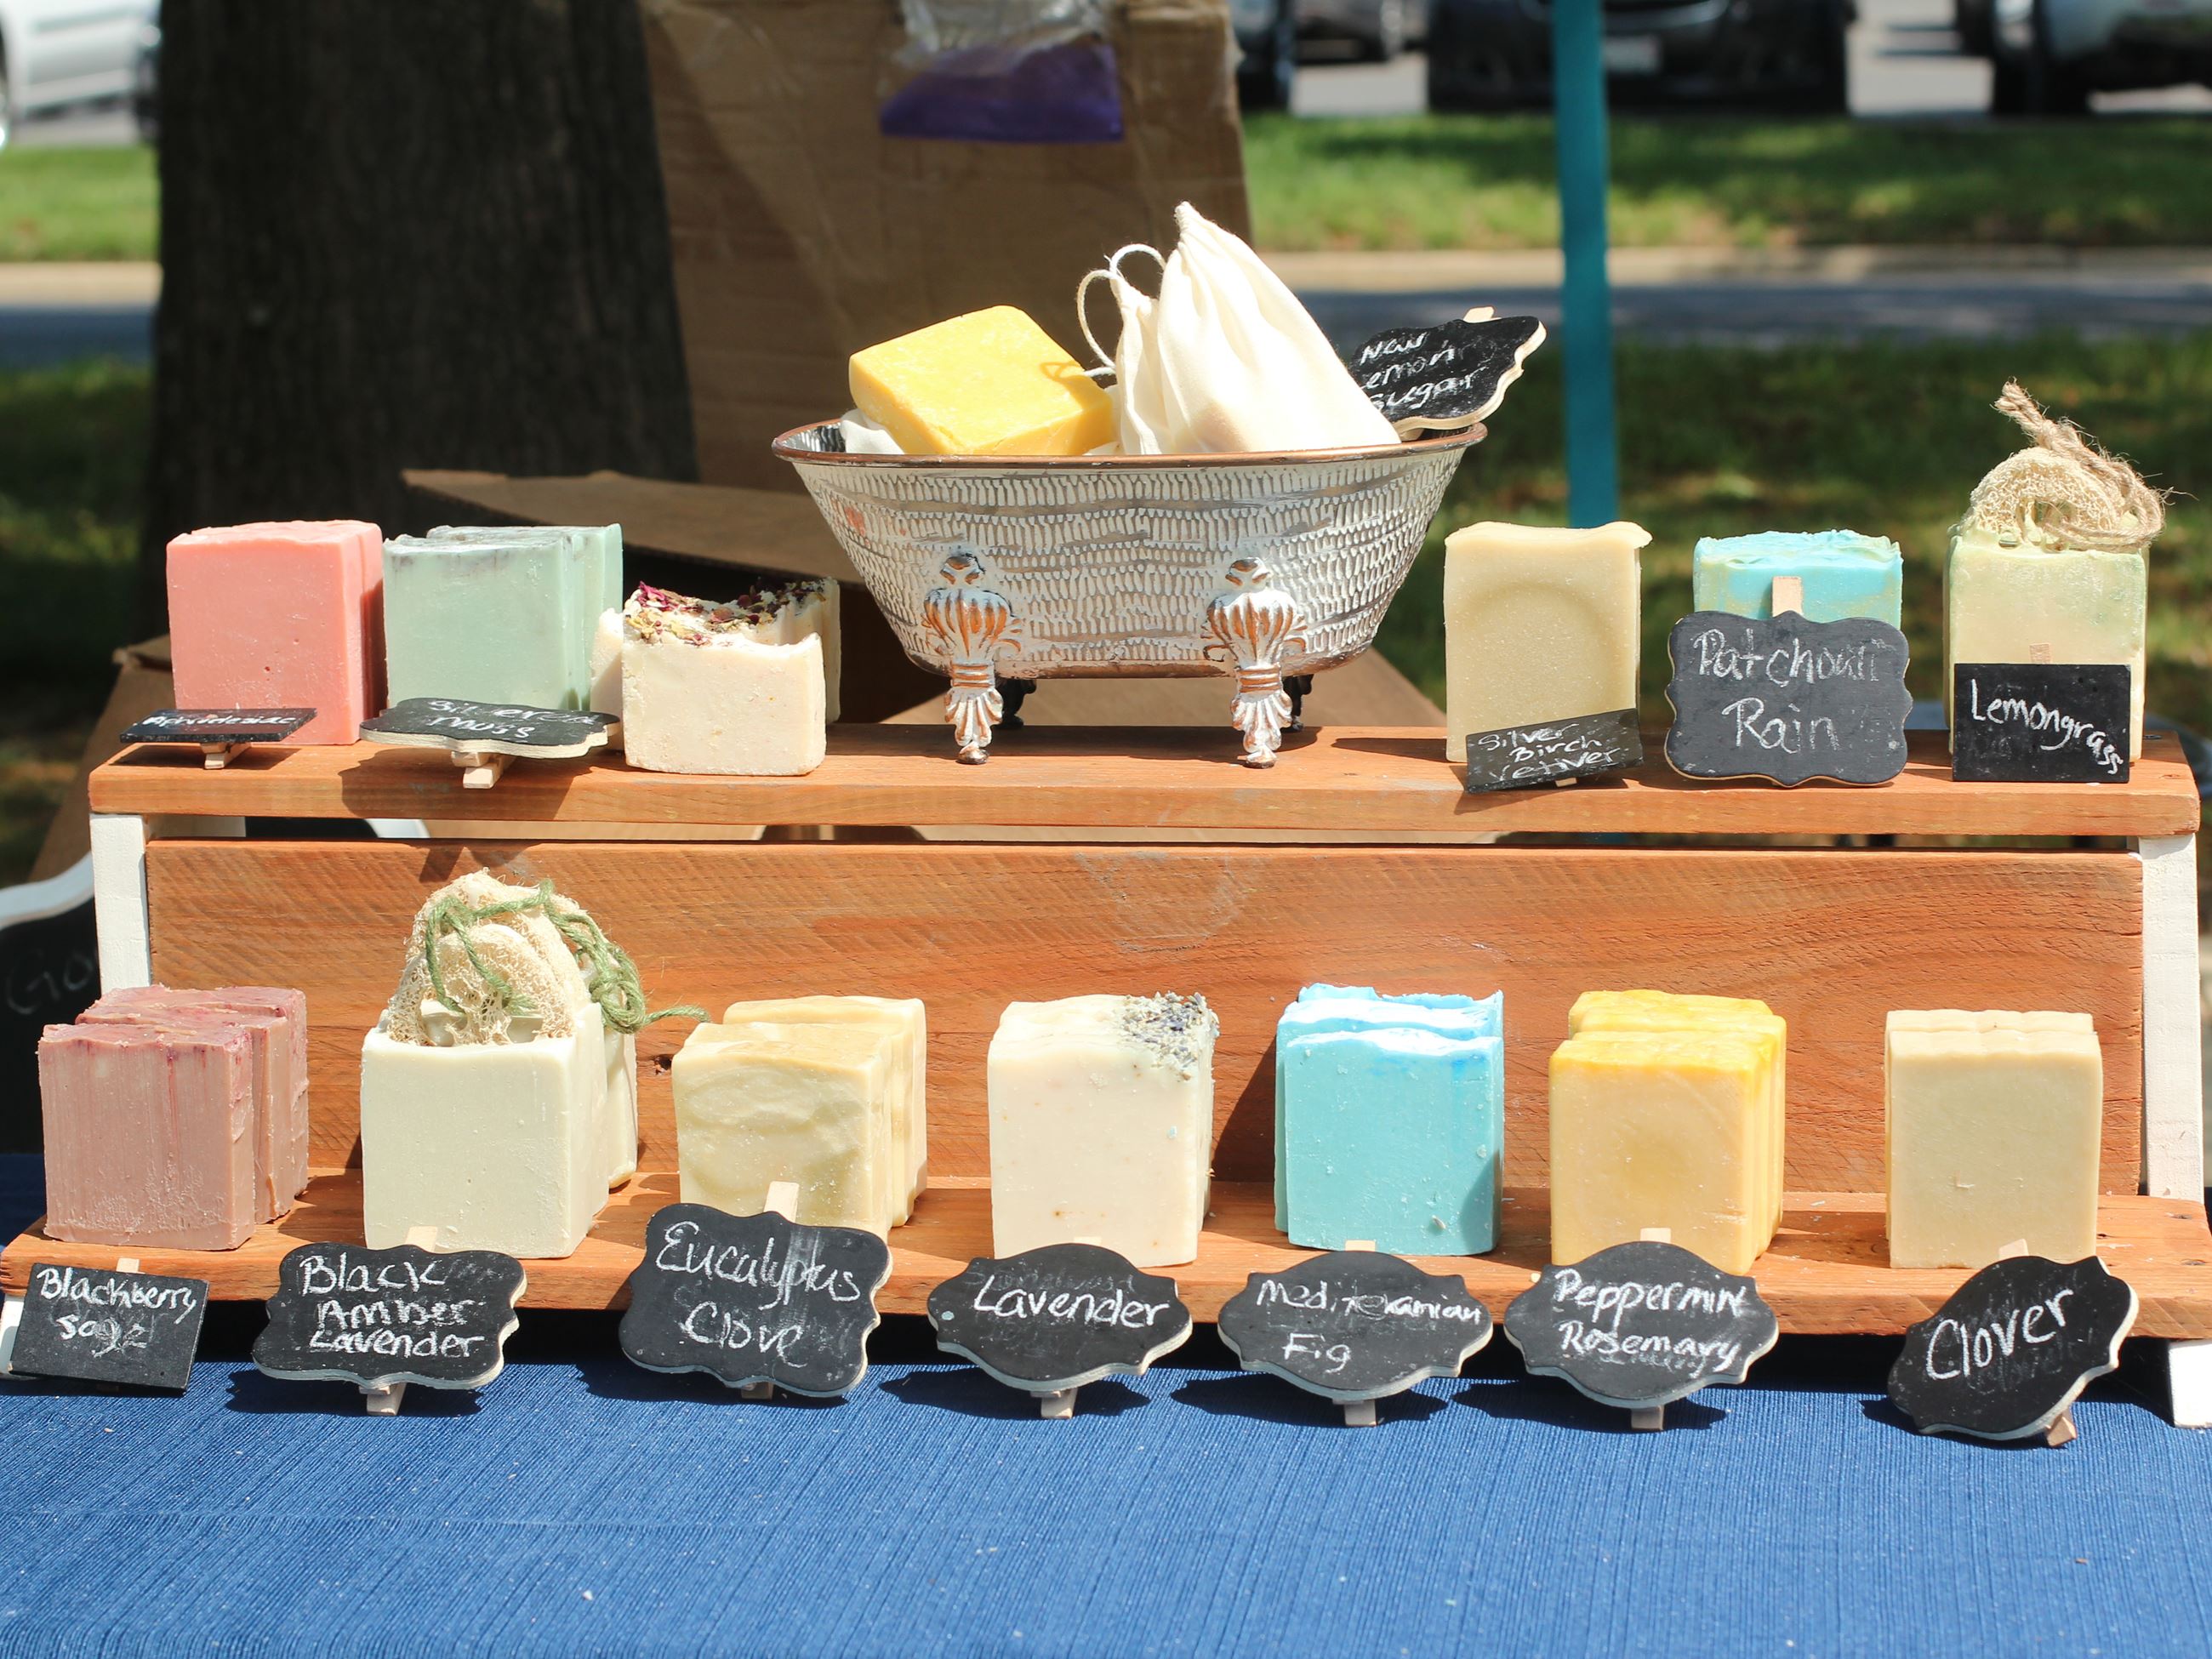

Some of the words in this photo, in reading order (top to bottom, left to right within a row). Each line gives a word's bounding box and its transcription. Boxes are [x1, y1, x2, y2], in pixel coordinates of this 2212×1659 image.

[1361, 347, 1456, 389] emon
[427, 699, 601, 726] Silered
[1477, 723, 1580, 750] Silver
[1721, 696, 1840, 755] Rain
[1971, 679, 2124, 775] Lemongrass
[1509, 736, 1603, 762] Birch
[37, 1267, 197, 1325] Blackberry
[299, 1251, 448, 1297] Black
[972, 1274, 1171, 1329] Lavender
[309, 1327, 486, 1358] Lavender
[679, 1301, 808, 1368] Clove
[1282, 1332, 1351, 1374] Fig
[1557, 1320, 1742, 1372] Rosemary
[1925, 1288, 2074, 1381] Clover
